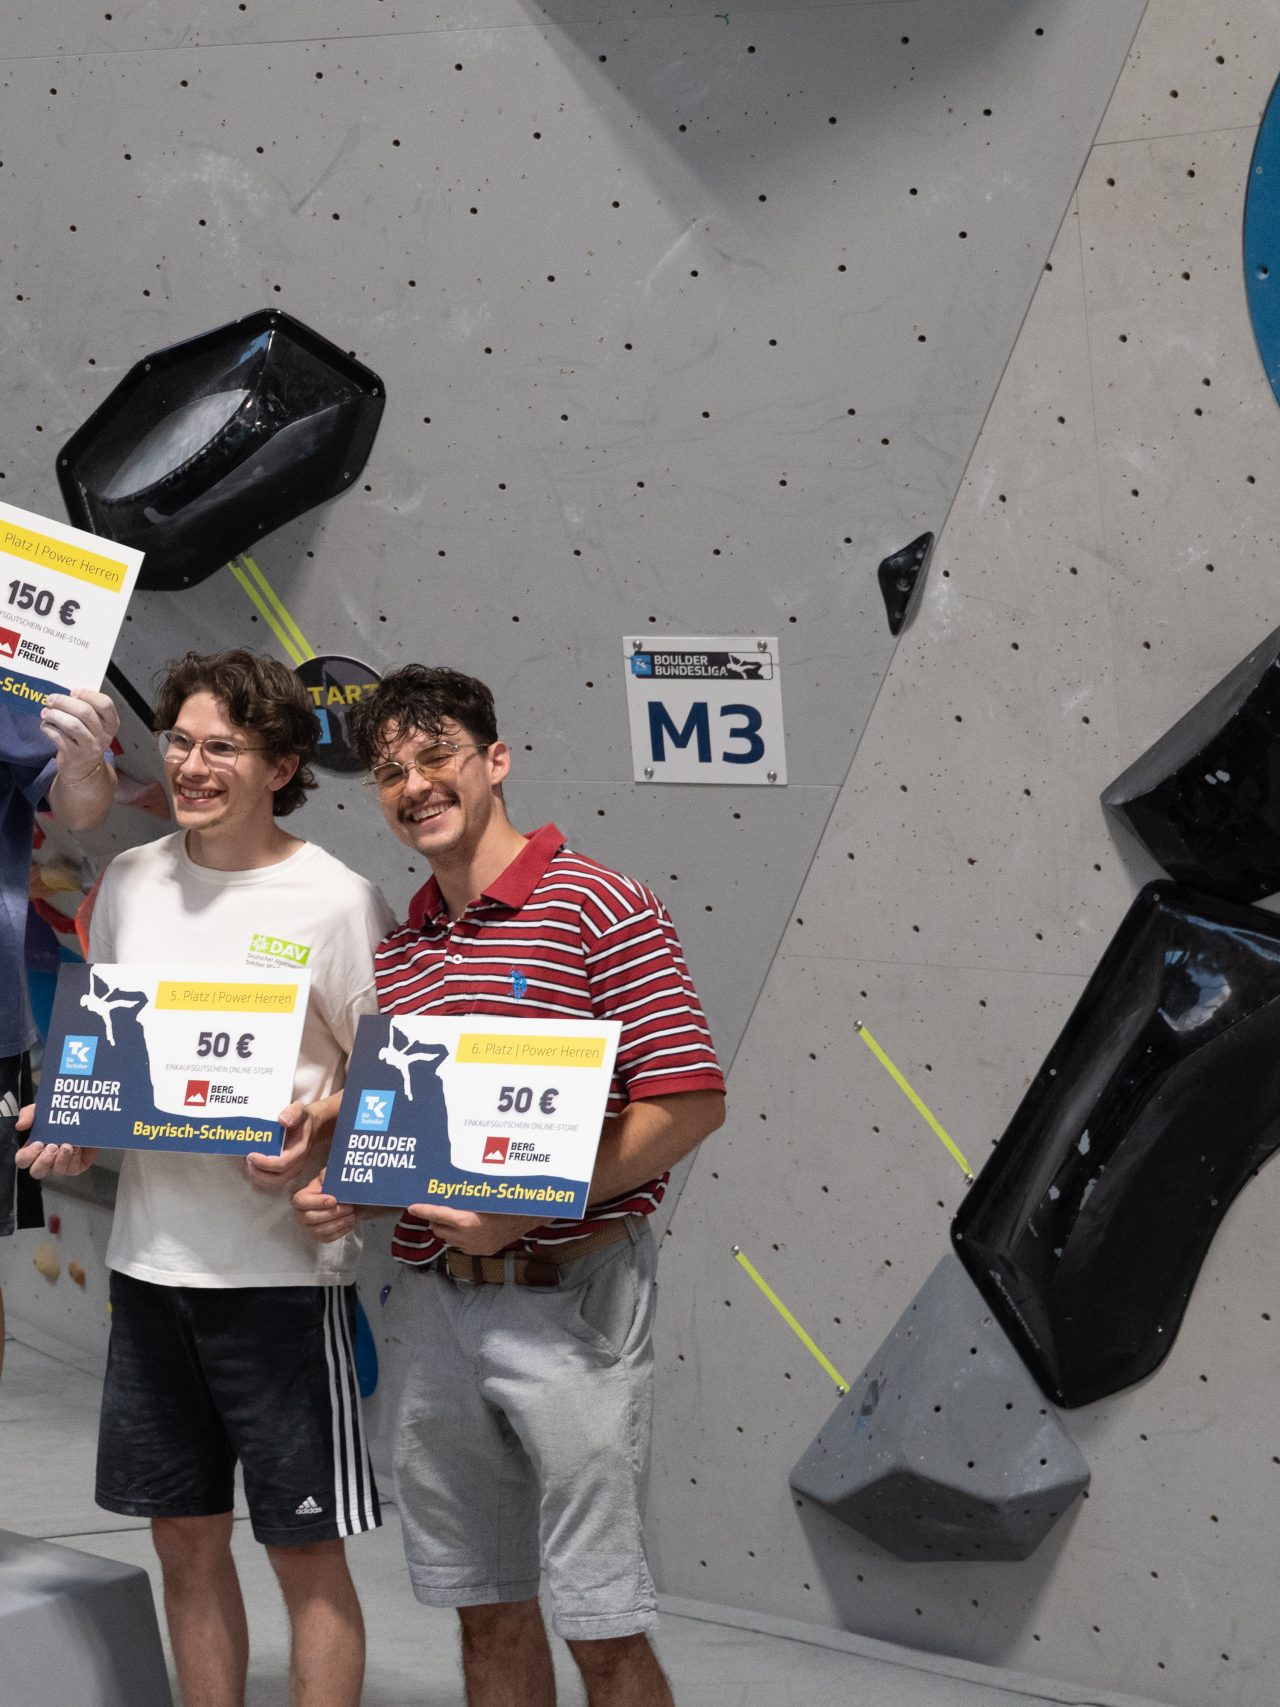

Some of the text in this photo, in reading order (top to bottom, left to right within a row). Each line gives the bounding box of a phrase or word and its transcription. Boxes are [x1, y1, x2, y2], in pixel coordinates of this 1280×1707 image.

[5, 532, 33, 552] Platz
[42, 546, 77, 568] Power
[80, 561, 119, 582] Herren
[8, 579, 81, 626] 150 €
[43, 623, 90, 649] ONLINE-STORE
[20, 639, 45, 655] BERG
[17, 649, 60, 671] FREUNDE
[654, 655, 708, 666] BOULDER
[654, 666, 728, 676] BUNDESLIGA
[307, 683, 379, 706] TART
[648, 701, 765, 765] M3
[270, 940, 307, 961] DAV
[170, 991, 180, 1001] 5.
[183, 990, 210, 1002] Platz
[219, 991, 253, 1004] Power
[255, 992, 291, 1004] Herren
[196, 1031, 255, 1058] 50 €
[471, 1042, 482, 1054] 6.
[485, 1042, 513, 1056] Platz
[522, 1044, 557, 1057] Power
[560, 1045, 600, 1059] Herren
[165, 1063, 274, 1075] EINKAUFSGUTSCHEIN ONLINE-STORE
[54, 1078, 120, 1096] BOULDER
[211, 1085, 234, 1094] BERG
[51, 1094, 122, 1112] REGIONAL
[209, 1094, 249, 1105] FREUNDE
[497, 1086, 560, 1115] 50 €
[48, 1110, 80, 1125] LIGA
[464, 1118, 579, 1132] EINKAUFSGUTSCHEIN ONLINE-STORE
[133, 1121, 273, 1143] Bayrisch-Schwaben
[348, 1134, 417, 1152] BOULDER
[510, 1142, 535, 1152] BERG
[344, 1152, 416, 1169] REGIONAL
[509, 1152, 551, 1162] FREUNDE
[341, 1168, 374, 1183] LIGA
[427, 1178, 575, 1203] Bayrisch-Schwaben
